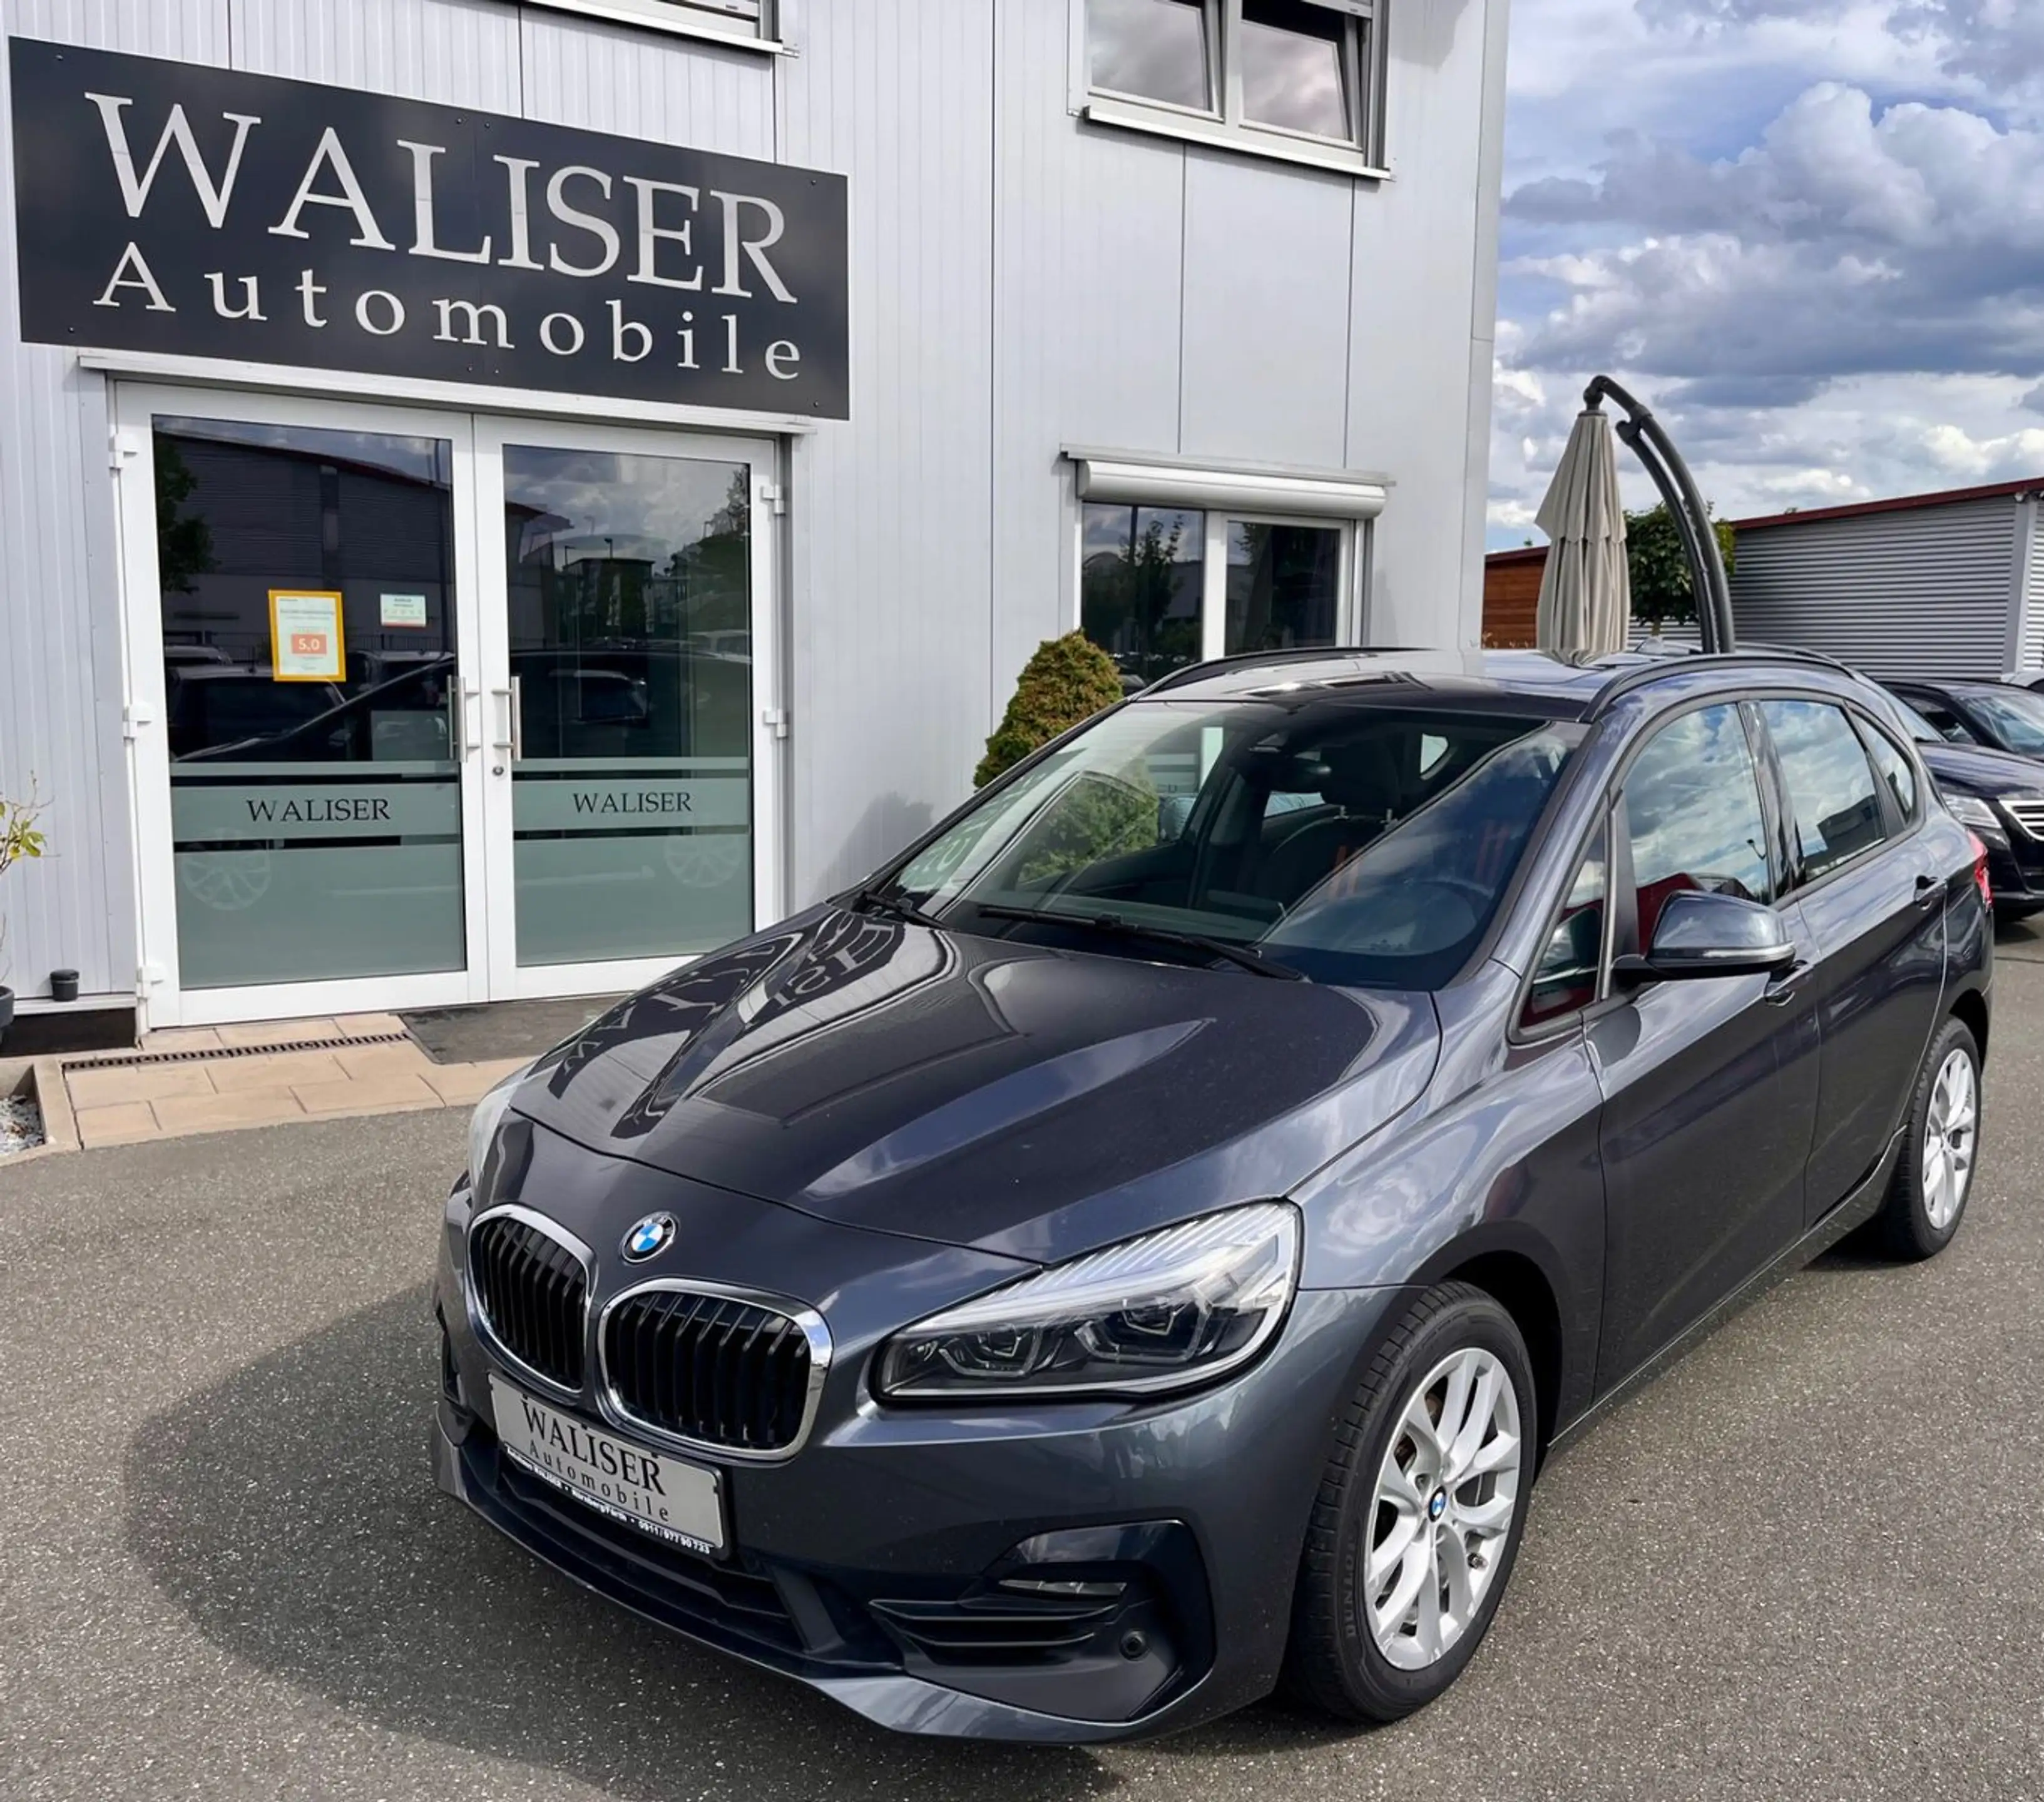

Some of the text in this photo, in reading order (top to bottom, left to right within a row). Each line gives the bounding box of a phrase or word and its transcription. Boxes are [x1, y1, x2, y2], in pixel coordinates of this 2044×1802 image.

[84, 91, 798, 304] WALISER
[93, 241, 800, 380] Automobile
[246, 798, 392, 823] WALISER
[573, 792, 693, 814] WALISER
[521, 1398, 667, 1497] WALISER
[529, 1440, 669, 1522] Automobile
